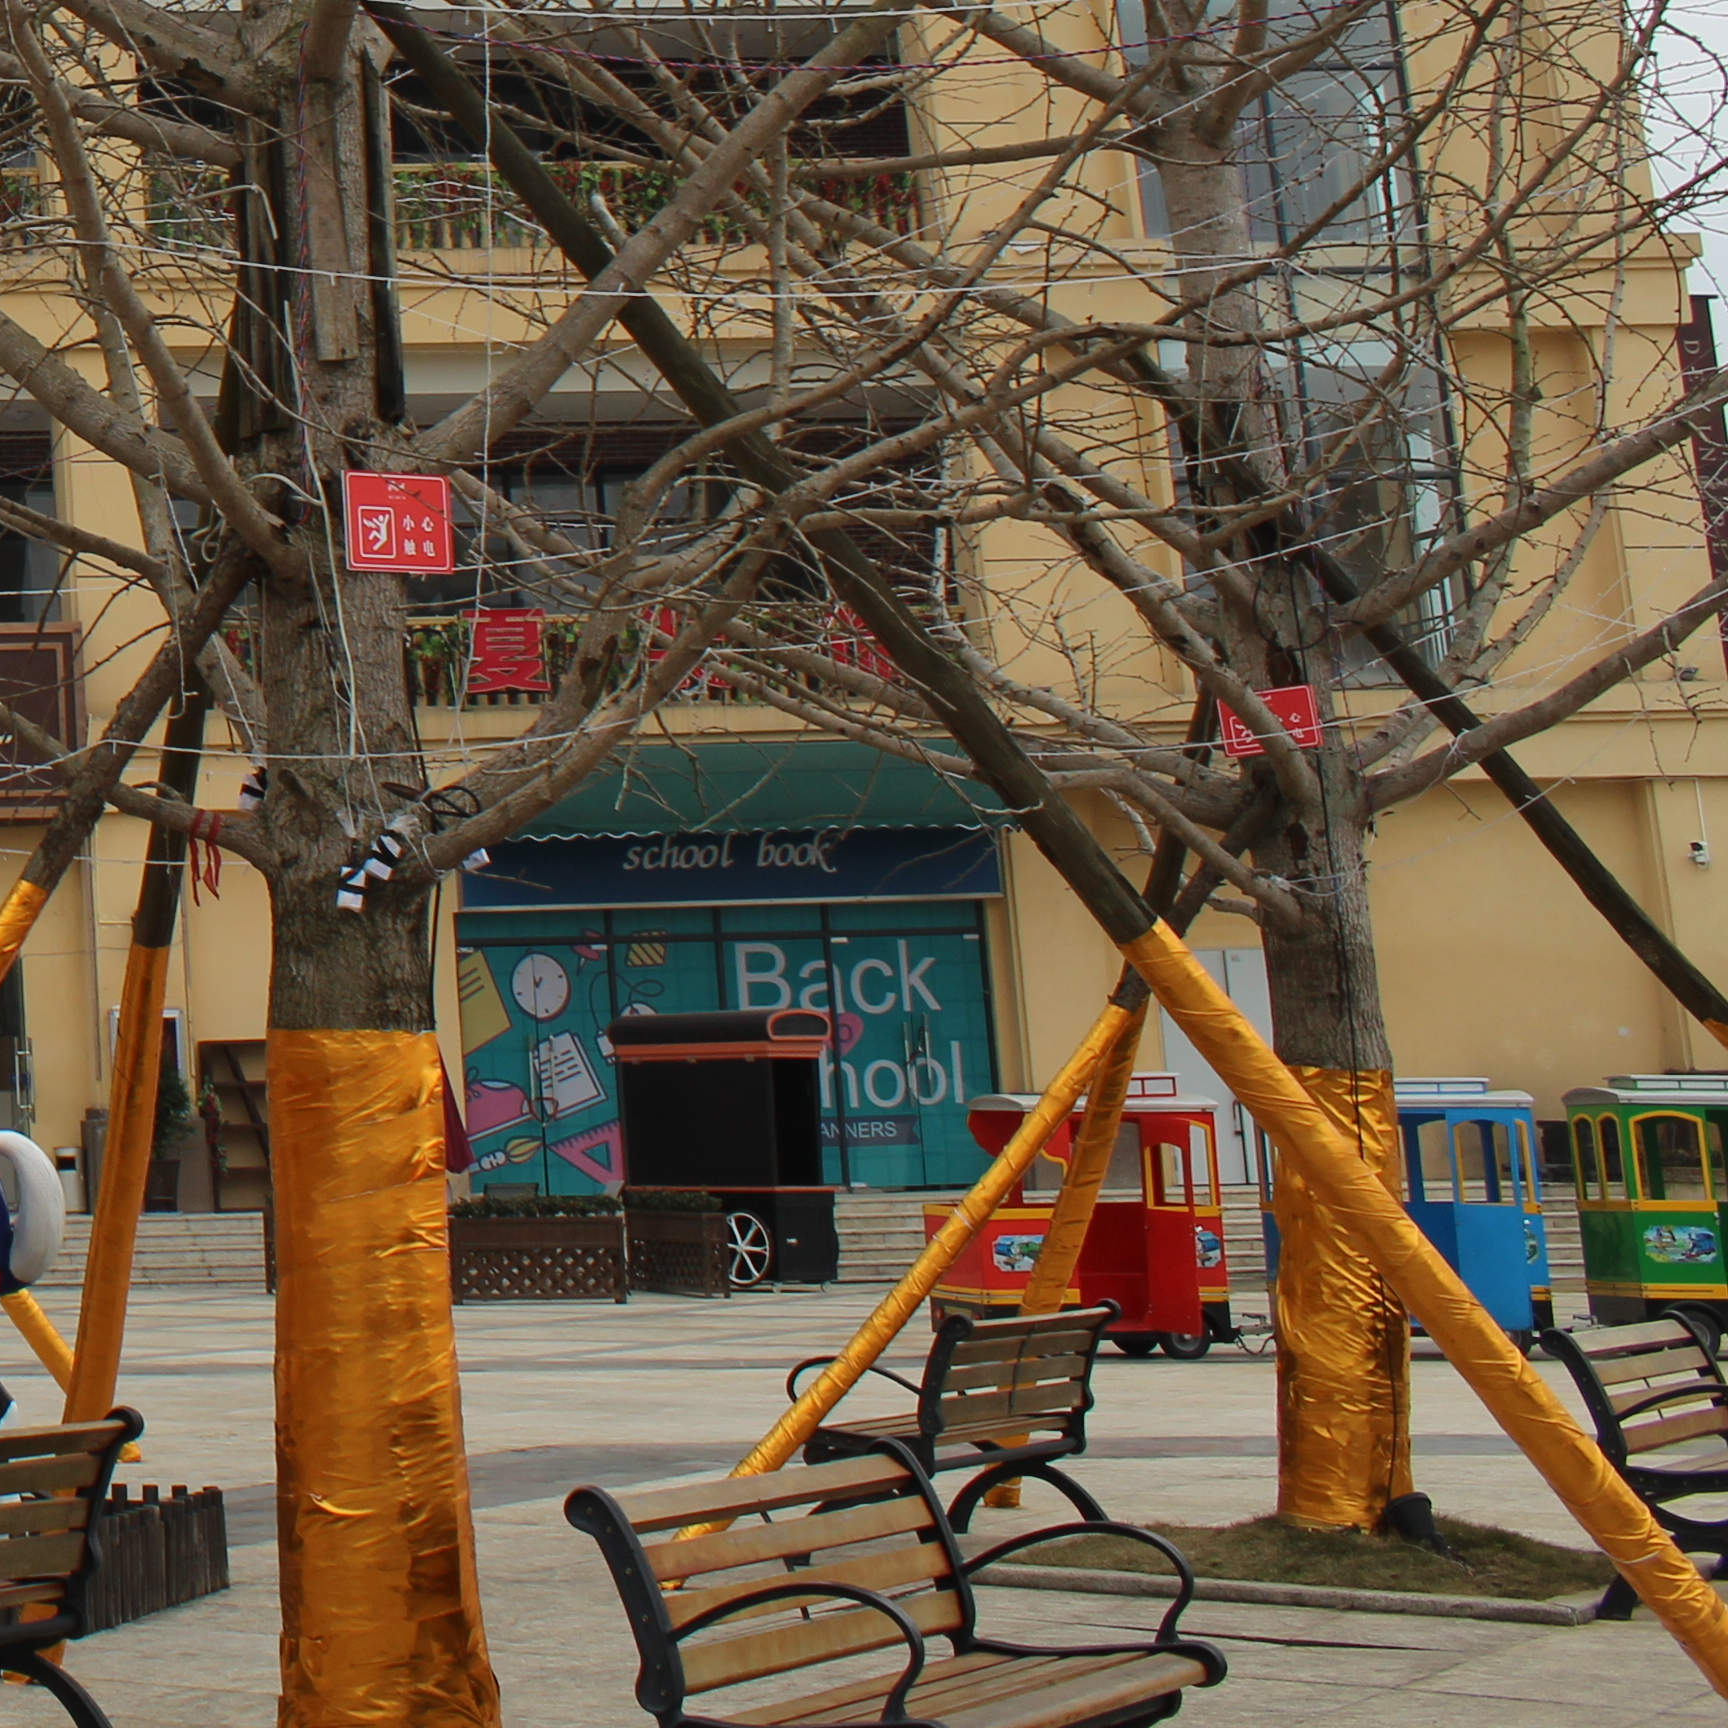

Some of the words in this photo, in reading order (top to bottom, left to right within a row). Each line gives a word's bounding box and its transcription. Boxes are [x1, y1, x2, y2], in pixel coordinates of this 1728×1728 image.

[403, 514, 435, 533] 小心
[622, 834, 735, 870] school
[756, 832, 840, 873] book
[734, 939, 943, 1014] Back
